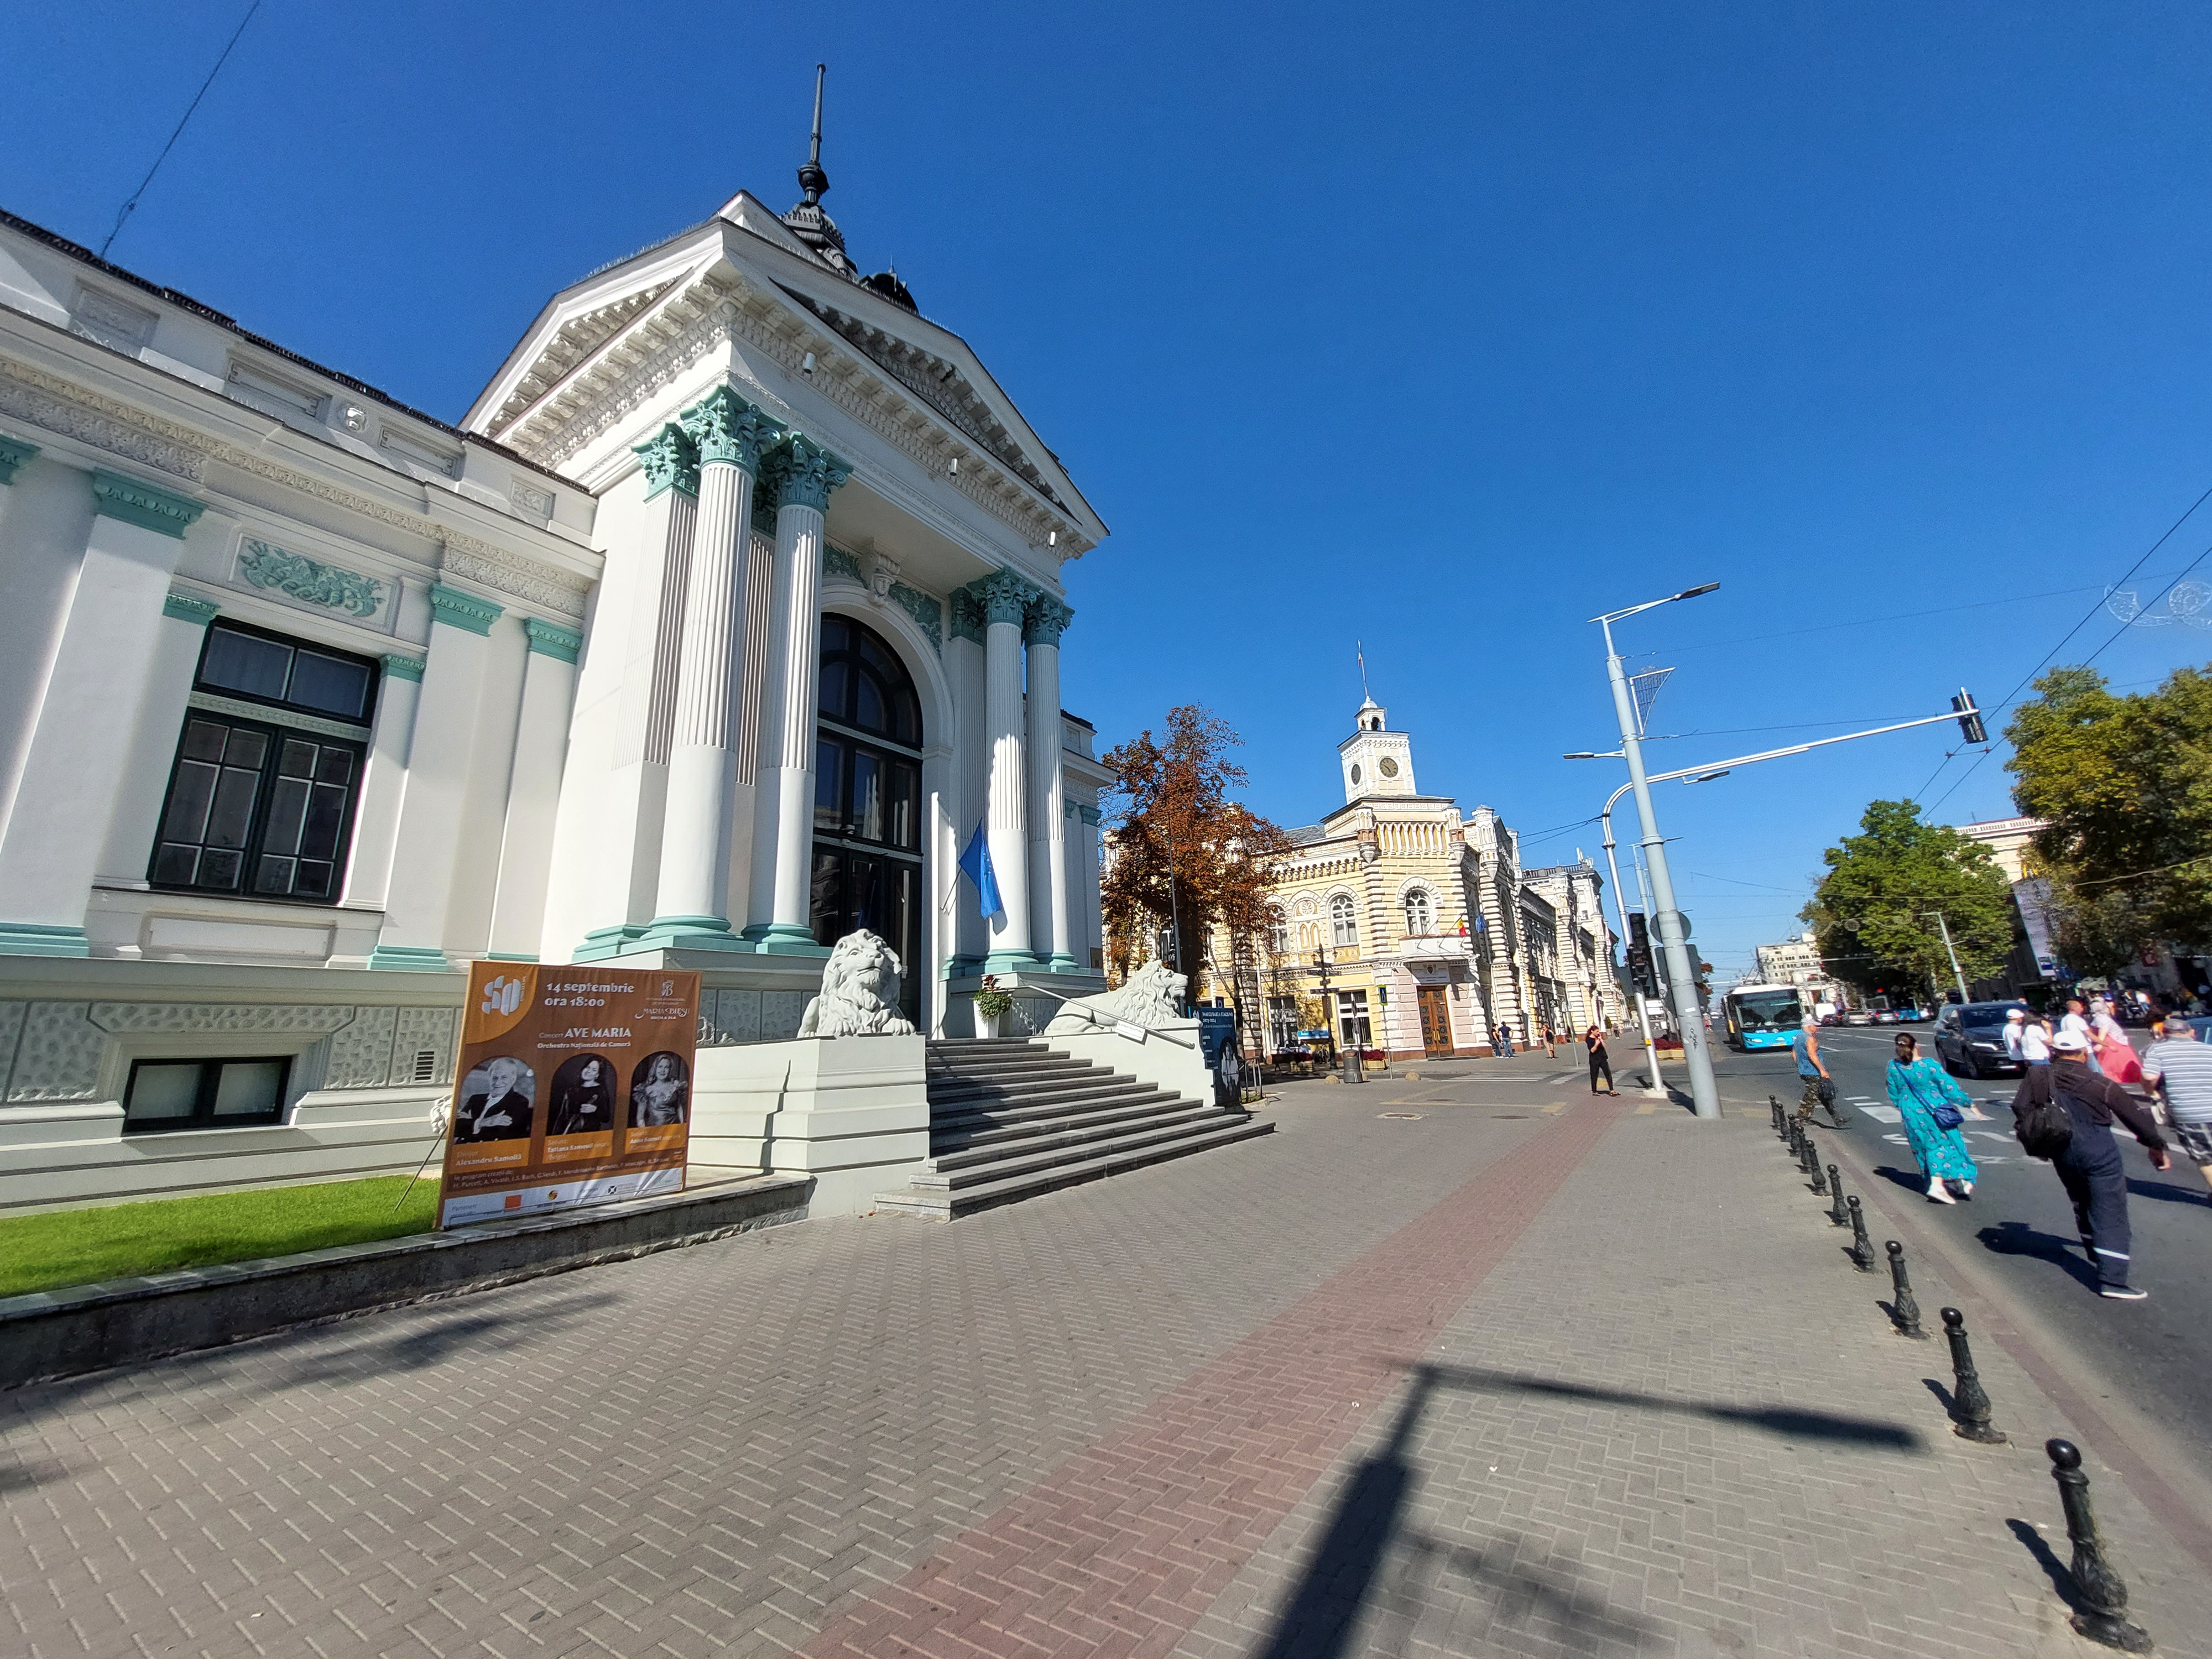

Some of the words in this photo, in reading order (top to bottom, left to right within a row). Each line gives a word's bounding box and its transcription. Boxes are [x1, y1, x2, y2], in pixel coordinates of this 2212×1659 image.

[546, 983, 561, 993] 14
[564, 983, 634, 993] septembrie
[545, 998, 567, 1006] ora
[570, 997, 605, 1006] 18:00
[564, 1027, 589, 1038] AVE
[591, 1027, 632, 1037] MARIA
[456, 1157, 492, 1166] Alexandru
